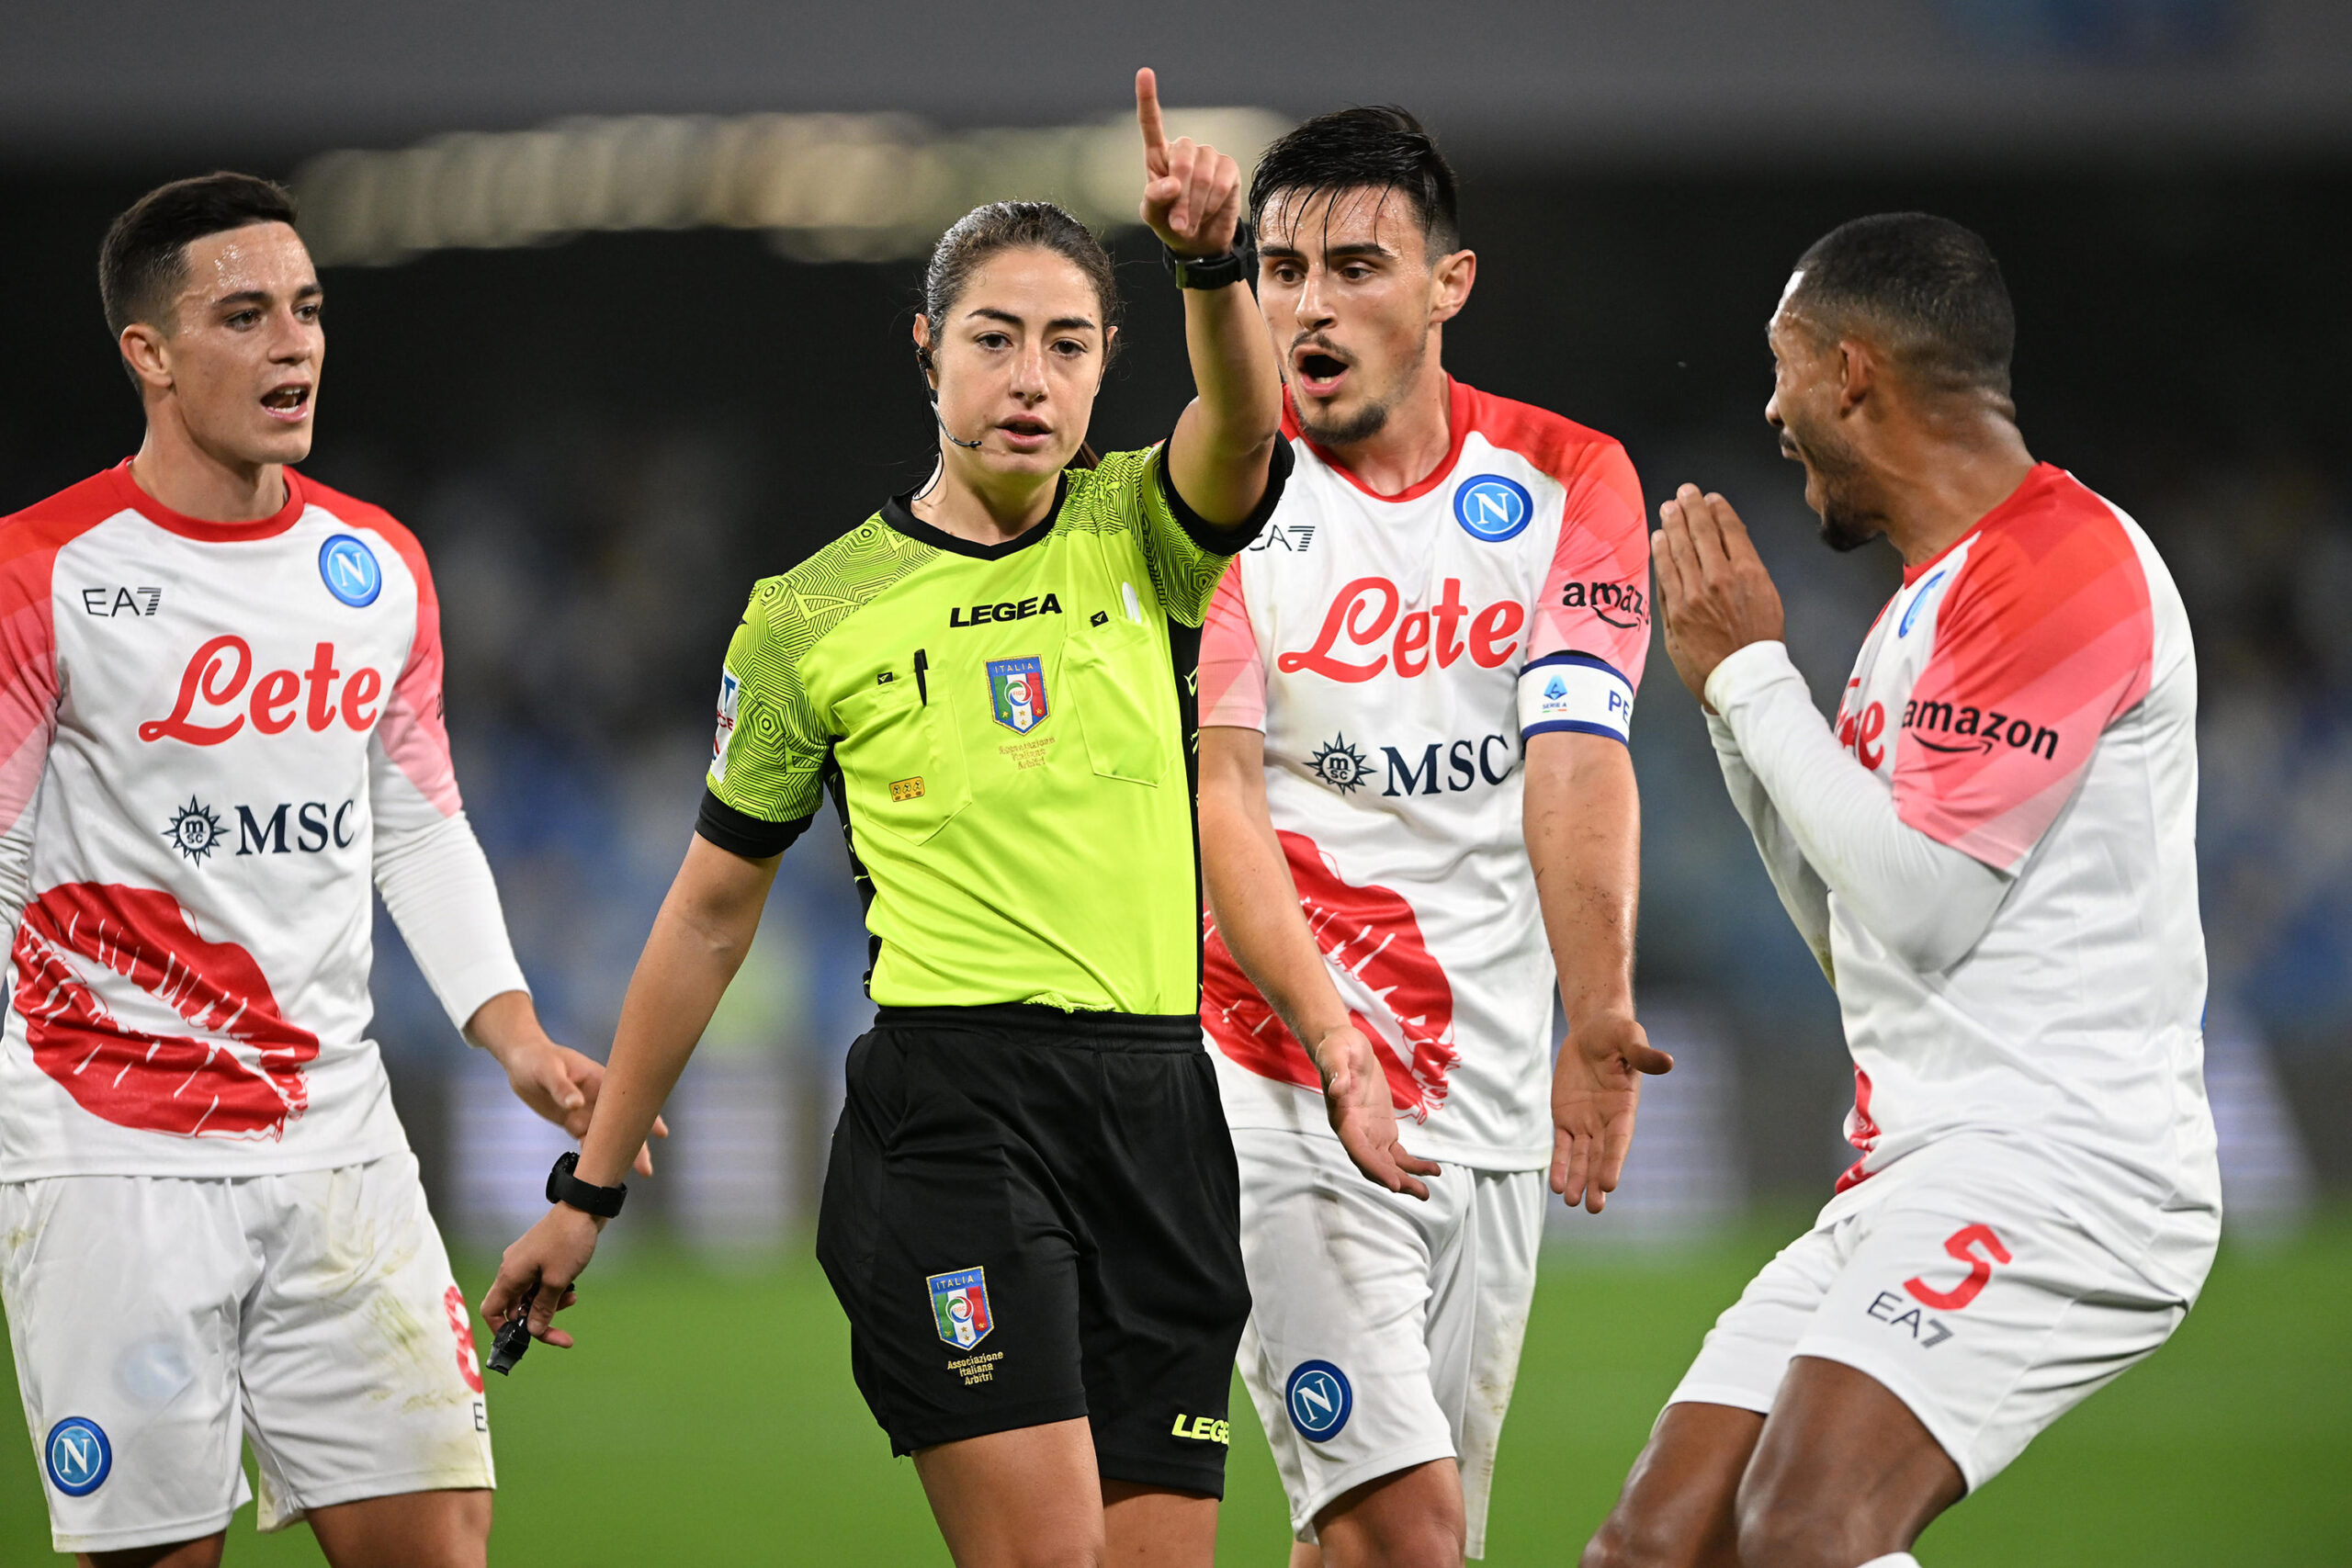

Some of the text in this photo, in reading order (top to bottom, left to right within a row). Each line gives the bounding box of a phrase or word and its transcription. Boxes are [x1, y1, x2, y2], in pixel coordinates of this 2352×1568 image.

[1474, 492, 1509, 524] N
[335, 553, 365, 586] N
[83, 587, 162, 617] EA7
[950, 593, 1062, 627] LEGEA
[1563, 581, 1649, 626] amaz
[1278, 577, 1524, 683] Lete
[994, 662, 1034, 673] ITALIA
[139, 635, 380, 746] Lete
[1903, 700, 2059, 761] amazon
[1380, 735, 1513, 796] MSC
[234, 798, 355, 855] MSC
[936, 1275, 974, 1290] ITALIA
[1903, 1224, 2012, 1310] 5
[1867, 1291, 1954, 1348] EA7
[947, 1351, 1003, 1370] Associazione
[959, 1362, 994, 1377] Italiana
[965, 1371, 993, 1385] Arbitri
[1302, 1379, 1332, 1423] N
[1171, 1414, 1229, 1445] LEGE
[62, 1438, 89, 1474] N
